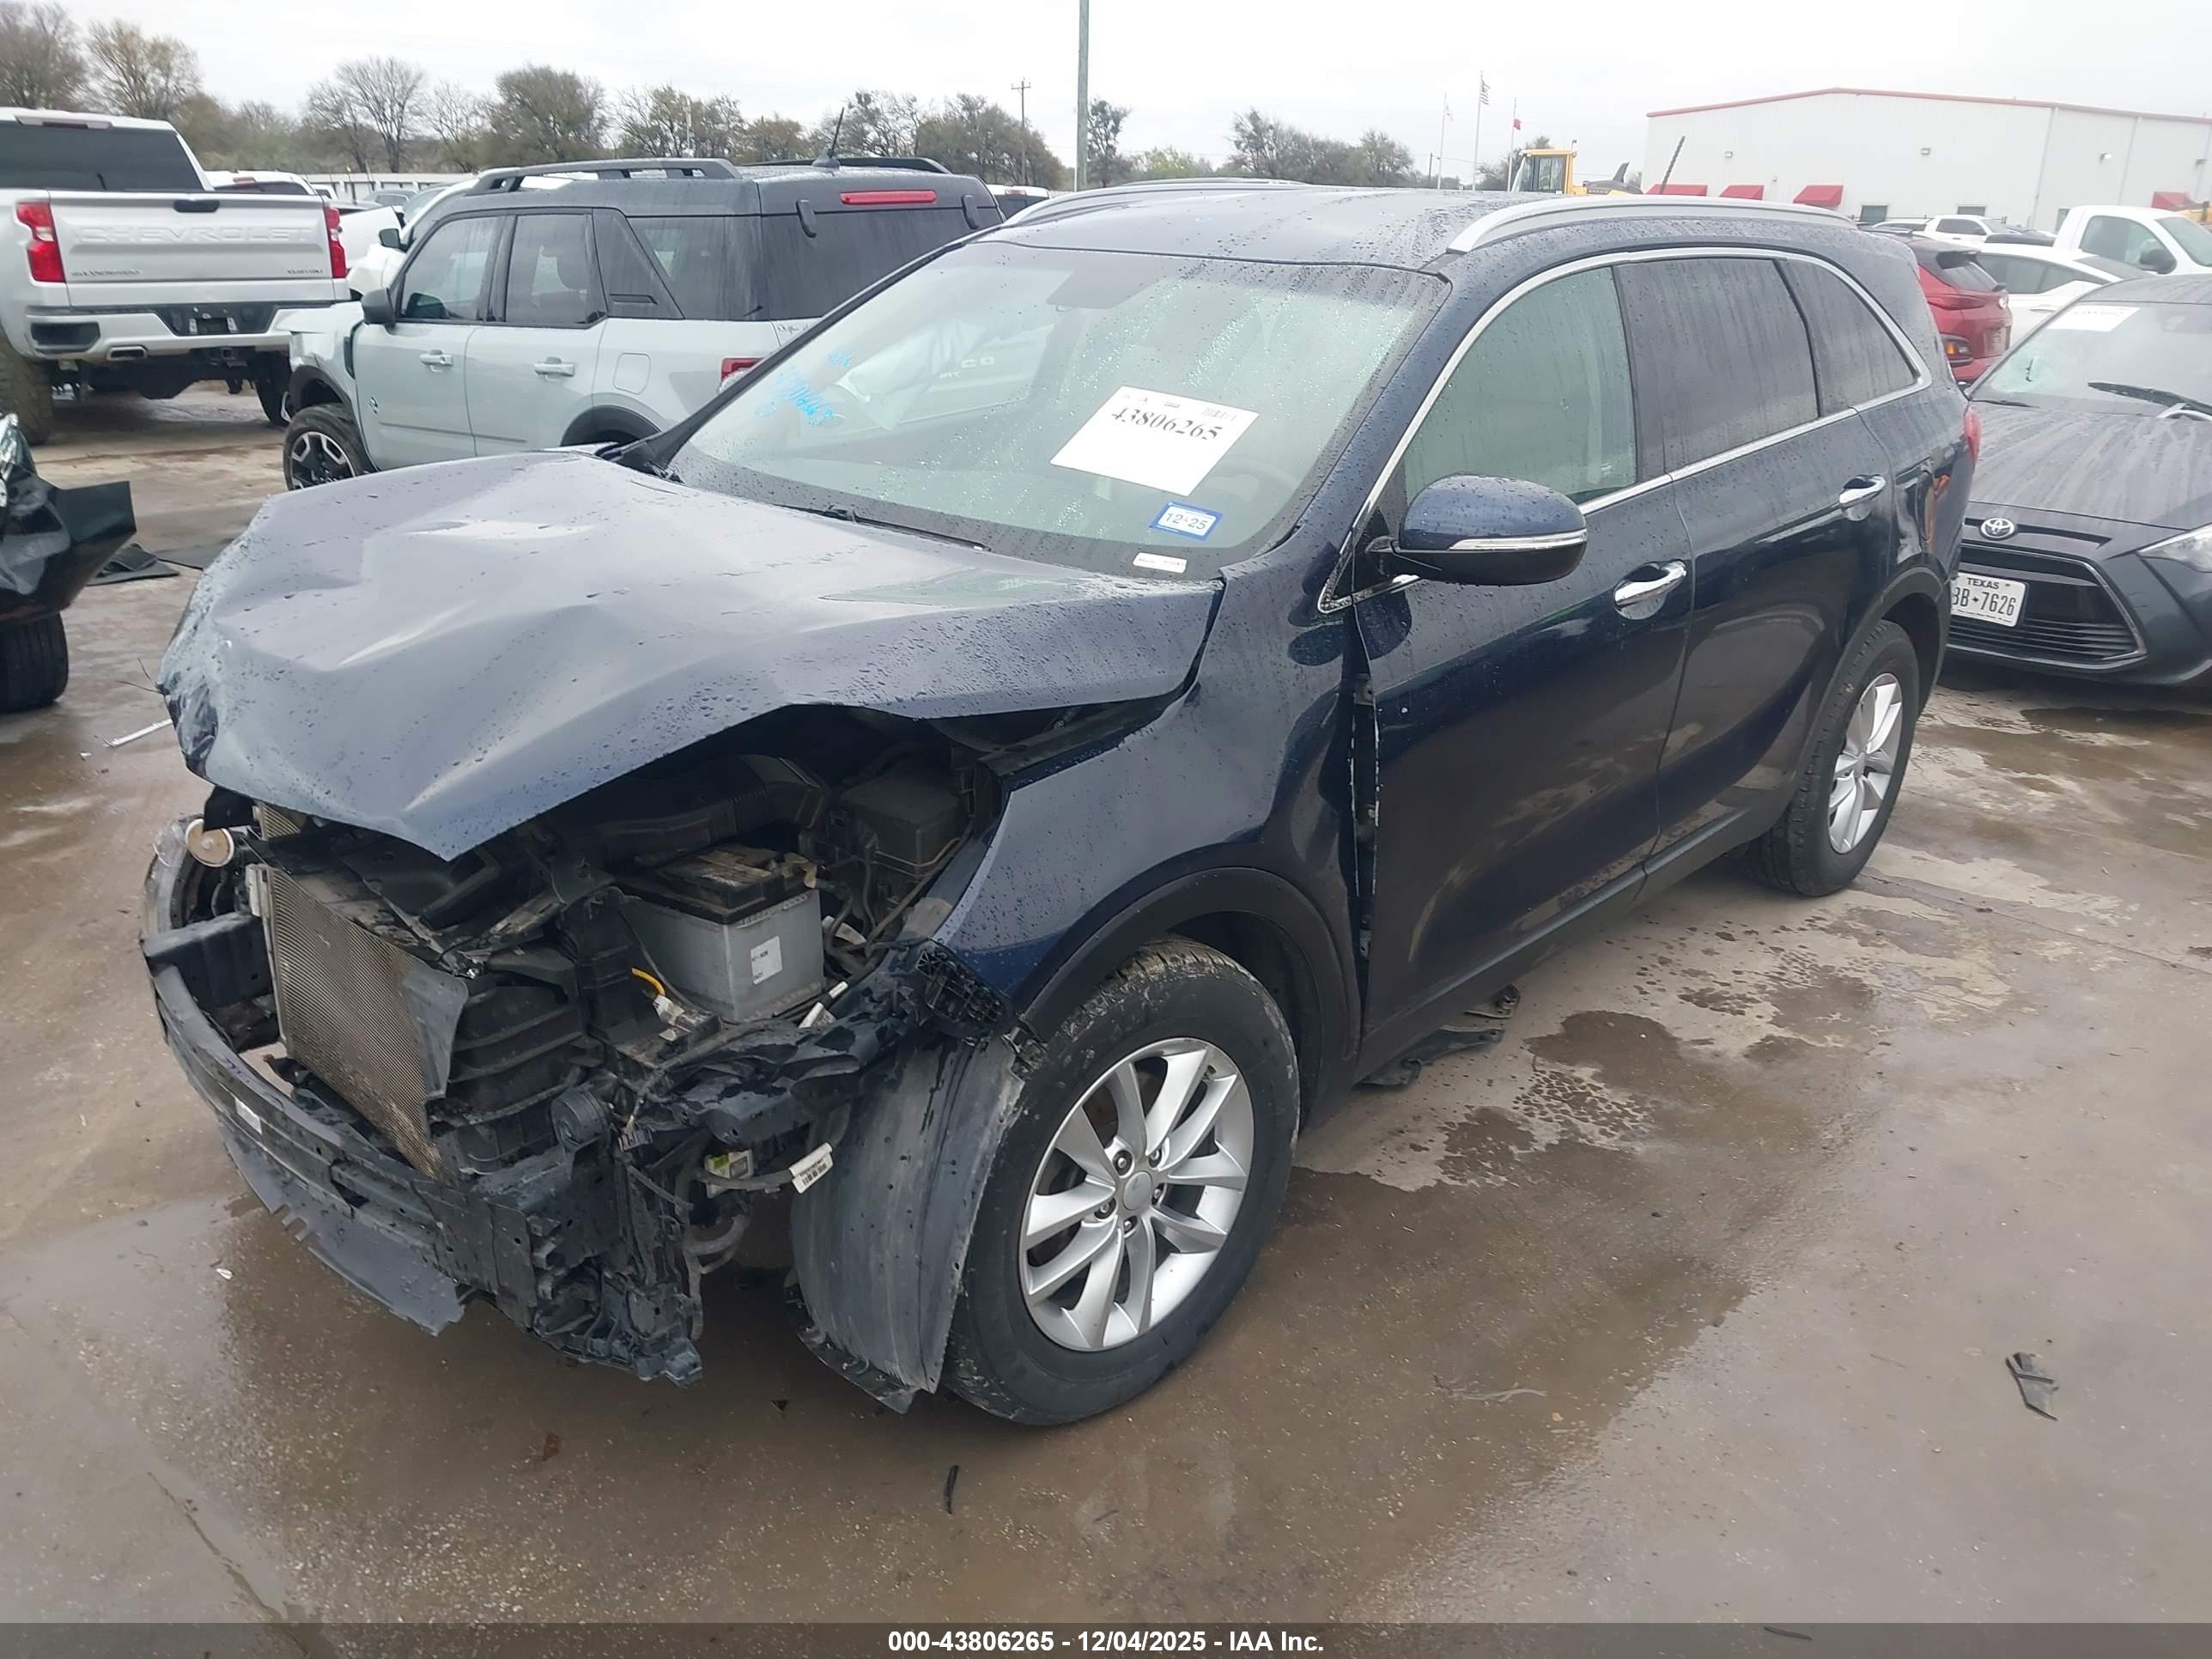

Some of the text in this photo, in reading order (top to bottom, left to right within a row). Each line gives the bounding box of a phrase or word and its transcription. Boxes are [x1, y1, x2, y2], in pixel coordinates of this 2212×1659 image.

[77, 226, 313, 243] CHEVROLET
[1111, 407, 1223, 440] 43806265
[1966, 577, 2000, 590] TEXAS
